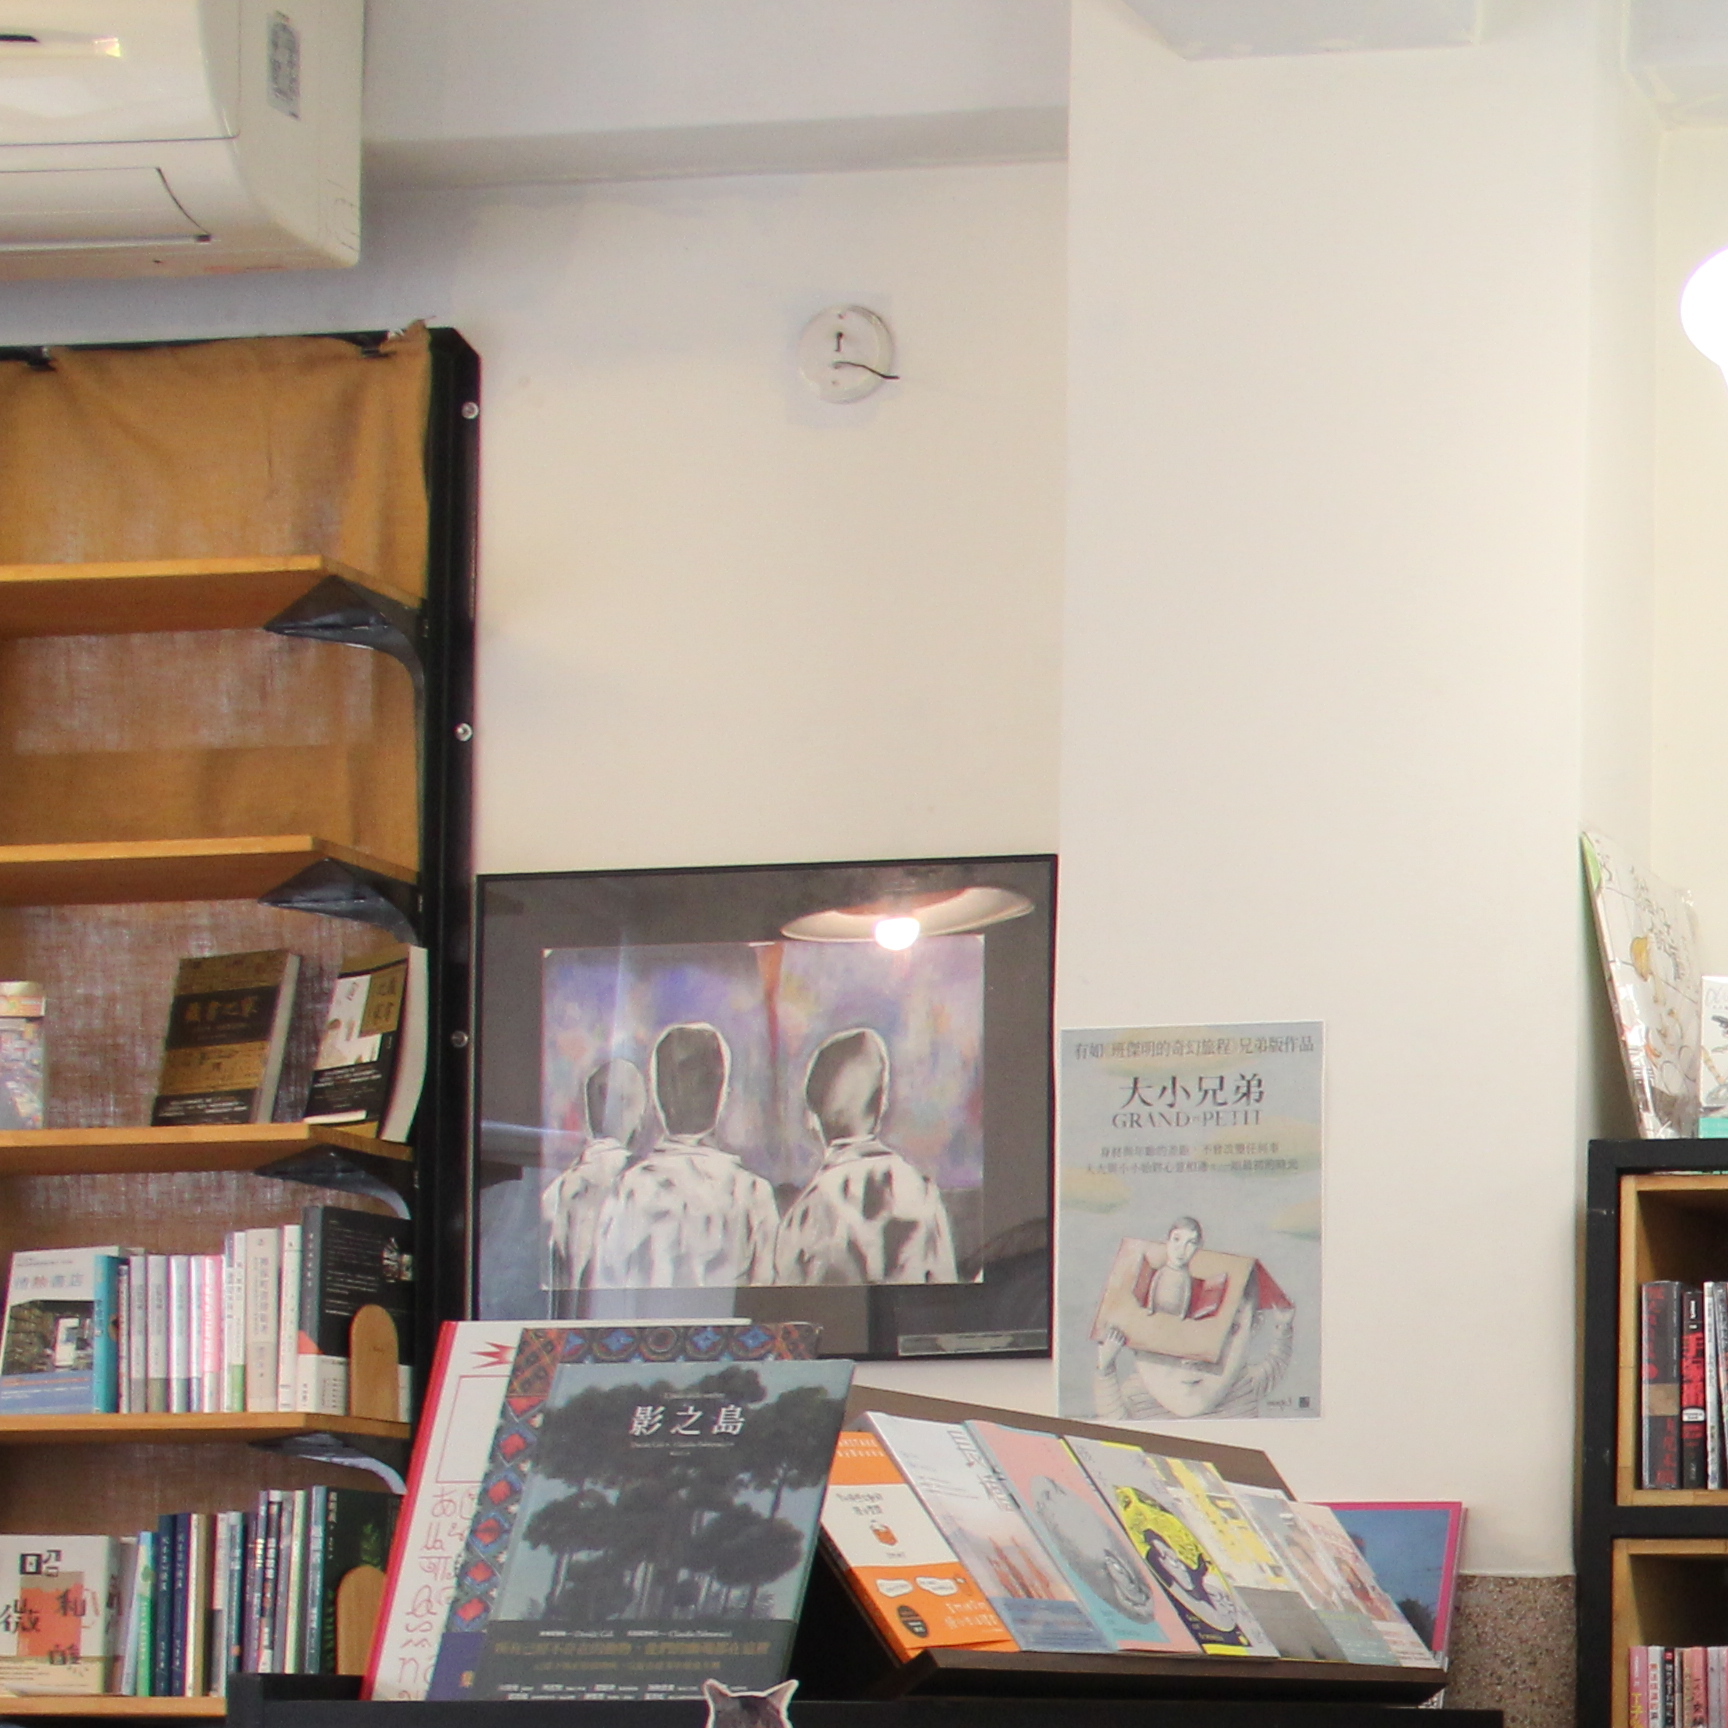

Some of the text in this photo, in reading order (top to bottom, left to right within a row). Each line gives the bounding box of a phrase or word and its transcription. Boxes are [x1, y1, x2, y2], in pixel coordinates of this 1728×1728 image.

[1119, 1073, 1266, 1109] 大小兄弟
[1111, 1109, 1264, 1128] GRAND PETIT
[629, 1404, 745, 1436] 影之島
